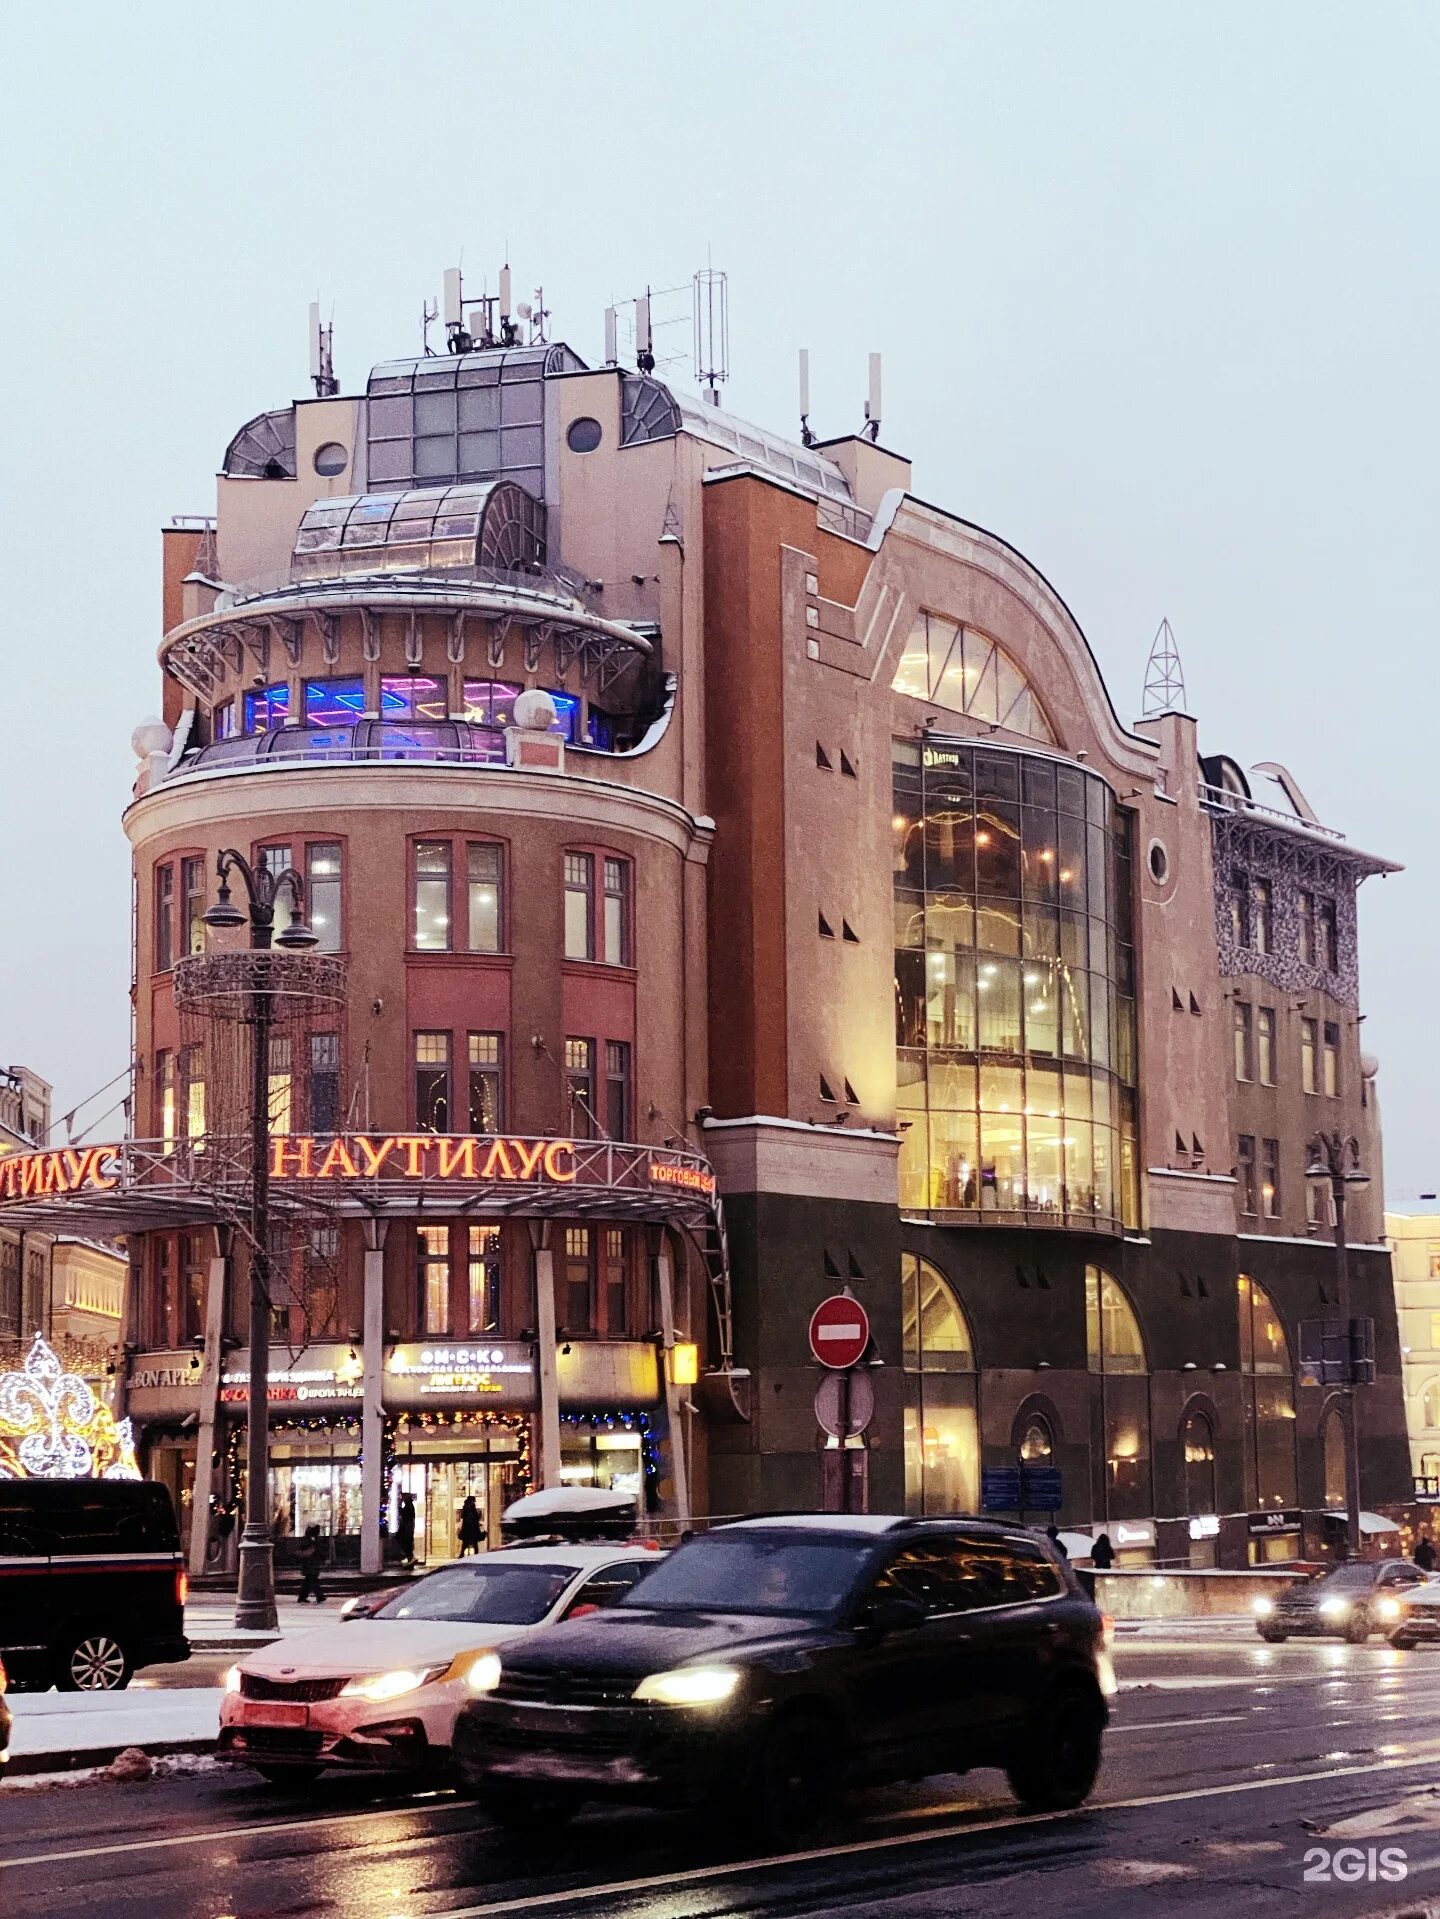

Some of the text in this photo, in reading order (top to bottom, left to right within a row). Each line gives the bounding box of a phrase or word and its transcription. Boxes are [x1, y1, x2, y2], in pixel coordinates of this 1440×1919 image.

[269, 1136, 577, 1181] НАУТИЛУС
[650, 1165, 700, 1188] ТОРГОВЫЙ
[220, 1388, 297, 1402] КАСААНКА
[308, 1388, 335, 1398] ШКОЛА
